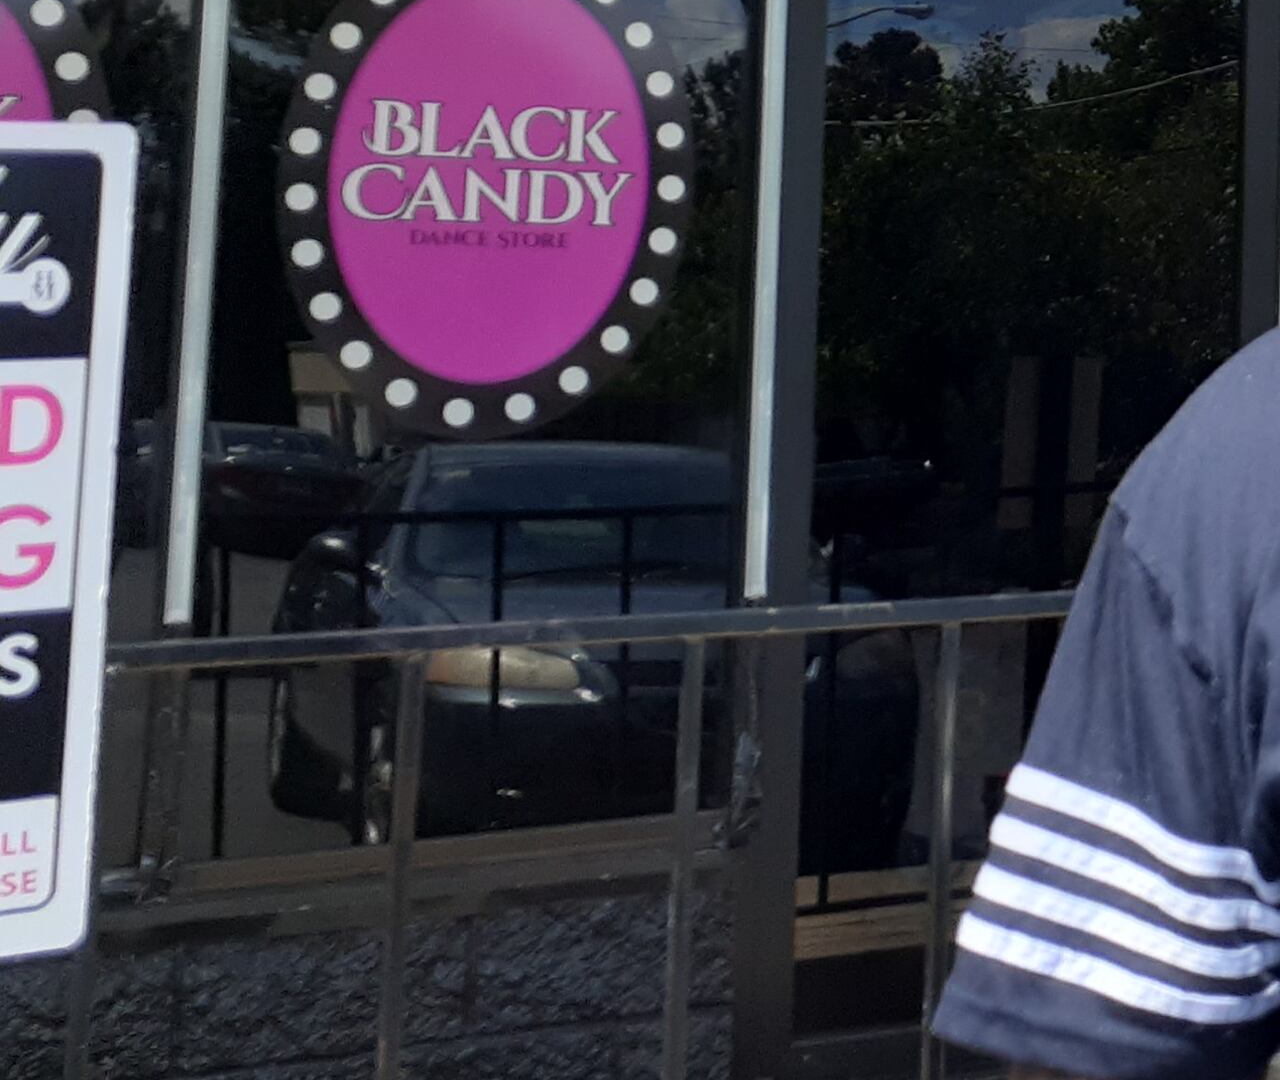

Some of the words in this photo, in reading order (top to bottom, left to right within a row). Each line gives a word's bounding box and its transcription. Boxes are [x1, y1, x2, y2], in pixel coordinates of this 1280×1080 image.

[363, 99, 620, 164] BLACK
[341, 163, 635, 227] CANDY
[409, 229, 487, 247] DANCE
[497, 230, 568, 249] STORE
